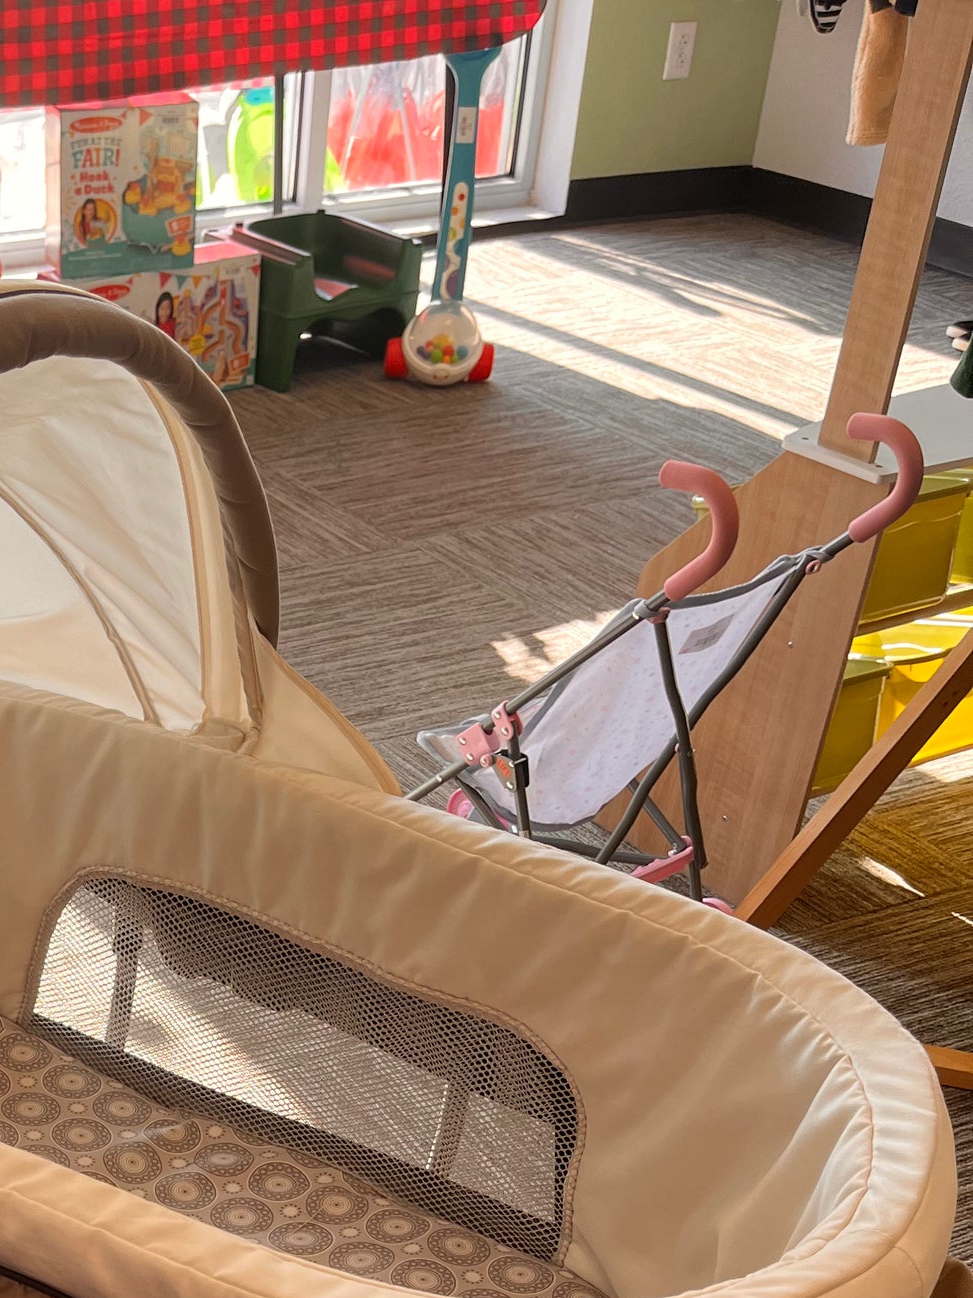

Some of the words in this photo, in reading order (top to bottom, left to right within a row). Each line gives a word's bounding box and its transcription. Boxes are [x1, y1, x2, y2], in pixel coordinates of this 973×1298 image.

[71, 147, 121, 169] FAIR!
[80, 170, 109, 183] Hook
[74, 187, 82, 195] a
[84, 183, 114, 195] Duck
